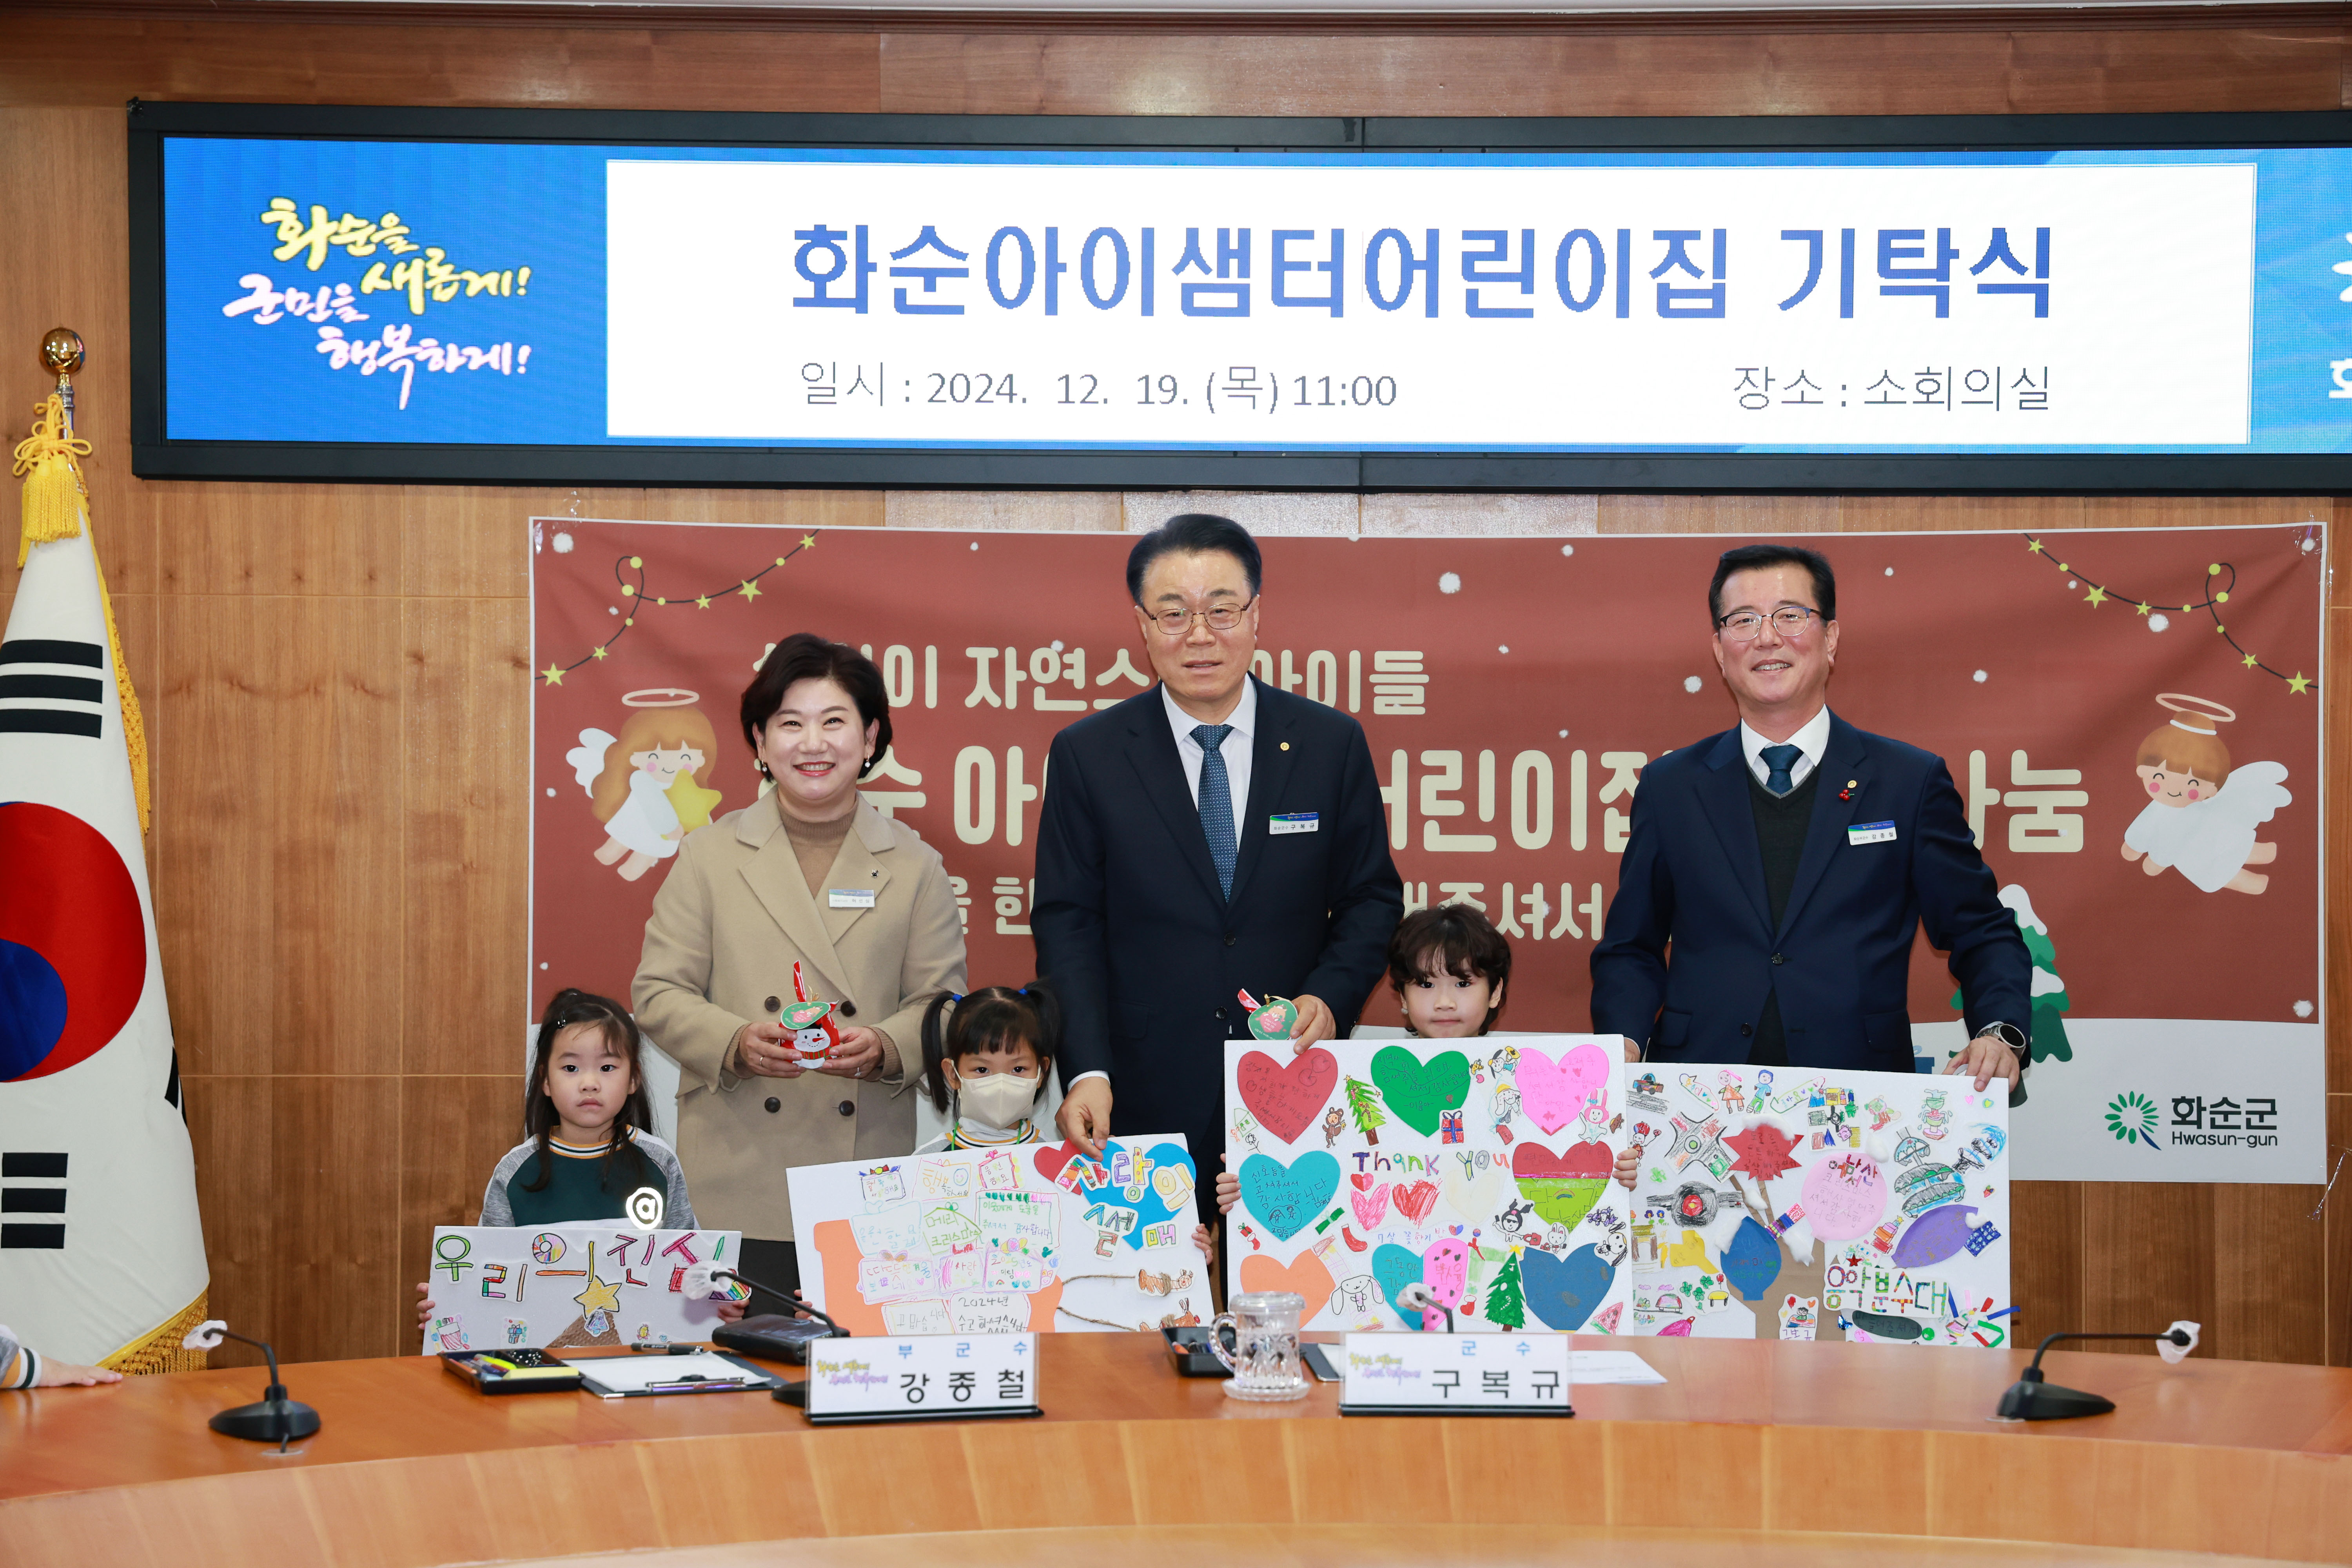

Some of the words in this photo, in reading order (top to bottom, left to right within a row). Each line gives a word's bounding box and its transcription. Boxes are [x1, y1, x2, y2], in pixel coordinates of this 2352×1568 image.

[261, 197, 419, 270] 화순을
[360, 248, 531, 313] 새롭게!
[793, 224, 1726, 319] 화순아이샘터어린이집
[1777, 227, 2051, 319] 기탁식
[222, 273, 370, 324] 군민을
[316, 324, 531, 410] 행복하게!
[802, 361, 883, 407] 일시
[927, 372, 1026, 404] 2024.
[1057, 374, 1108, 405] 12.
[1137, 374, 1188, 405] 19.
[1206, 366, 1278, 414] (목)
[1293, 375, 1396, 406] 11:00
[1734, 367, 1823, 411] 장소
[1864, 365, 2051, 412] 소회의실
[2171, 1096, 2278, 1130] 화순군
[2172, 1131, 2278, 1148] Hwasun-gun
